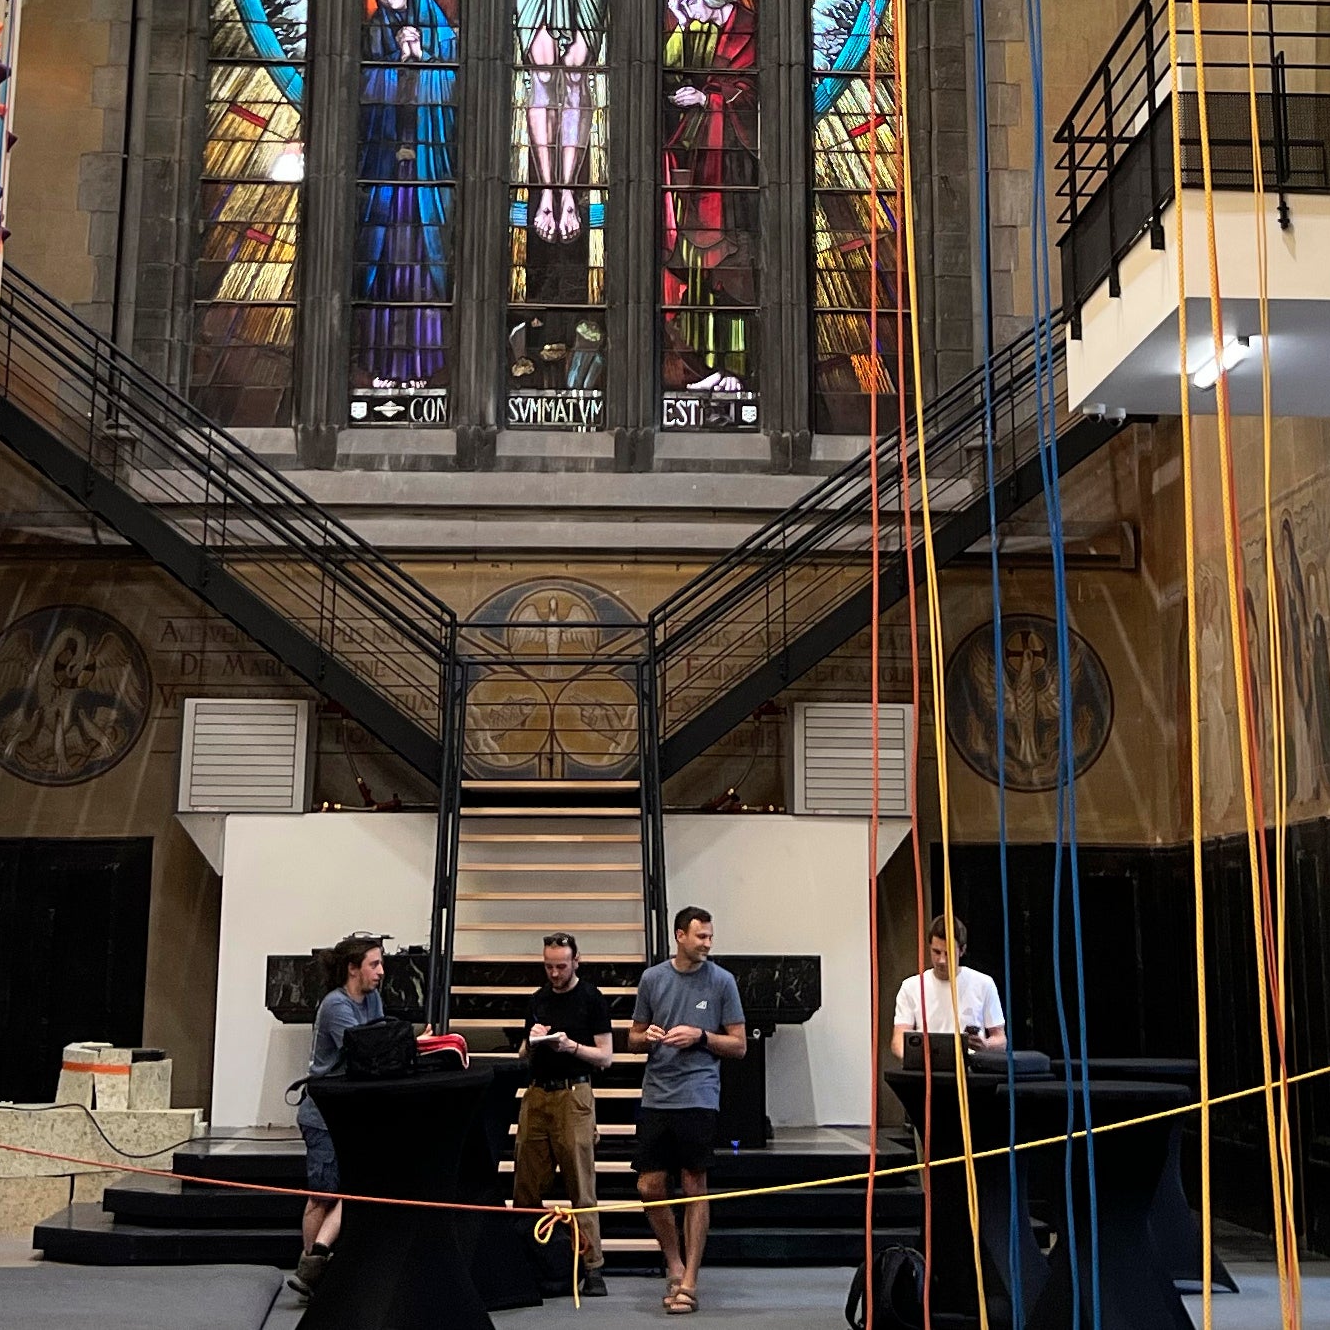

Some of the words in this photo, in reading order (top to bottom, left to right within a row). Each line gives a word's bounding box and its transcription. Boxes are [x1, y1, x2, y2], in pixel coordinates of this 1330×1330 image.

[410, 397, 447, 423] CON
[663, 399, 700, 427] EST
[222, 654, 283, 676] MARI
